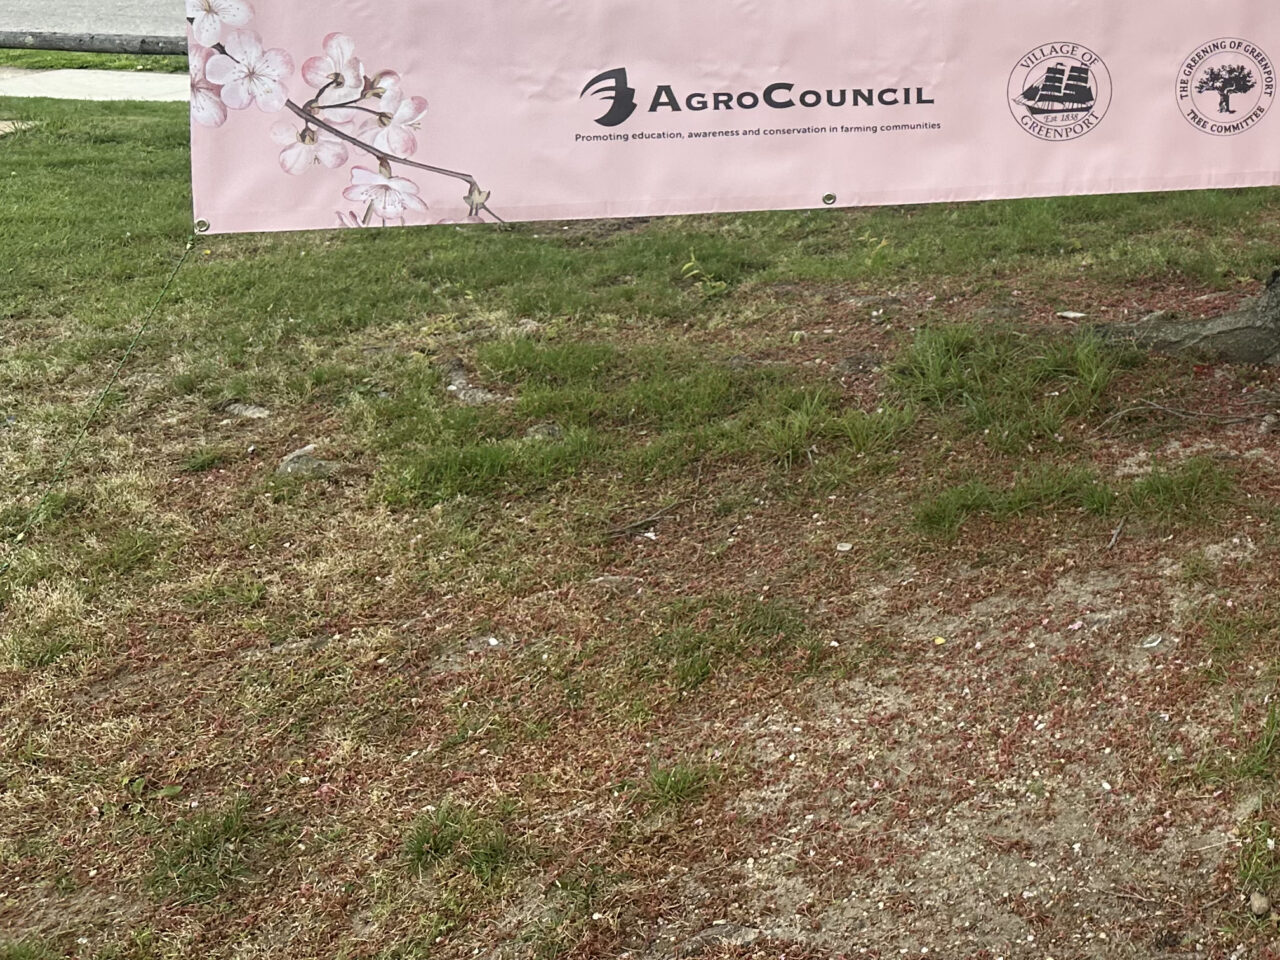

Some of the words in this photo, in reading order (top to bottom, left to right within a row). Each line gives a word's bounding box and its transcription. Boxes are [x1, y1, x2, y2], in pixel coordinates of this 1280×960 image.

[1020, 44, 1079, 69] VILLAGE
[1081, 51, 1099, 66] OF
[1229, 40, 1243, 50] OF
[1183, 41, 1226, 76] GREENING
[1243, 44, 1273, 97] GREENPORT
[1180, 78, 1188, 100] THE
[575, 132, 628, 142] Promoting
[632, 130, 684, 140] education,
[687, 129, 740, 138] awareness
[742, 127, 760, 136] and
[763, 125, 826, 135] conservation
[829, 125, 838, 133] in
[840, 124, 878, 134] farming
[880, 121, 941, 131] communities
[1020, 110, 1100, 138] GREENPORT
[1187, 109, 1209, 129] TREE
[1210, 105, 1265, 133] COMMITTEE
